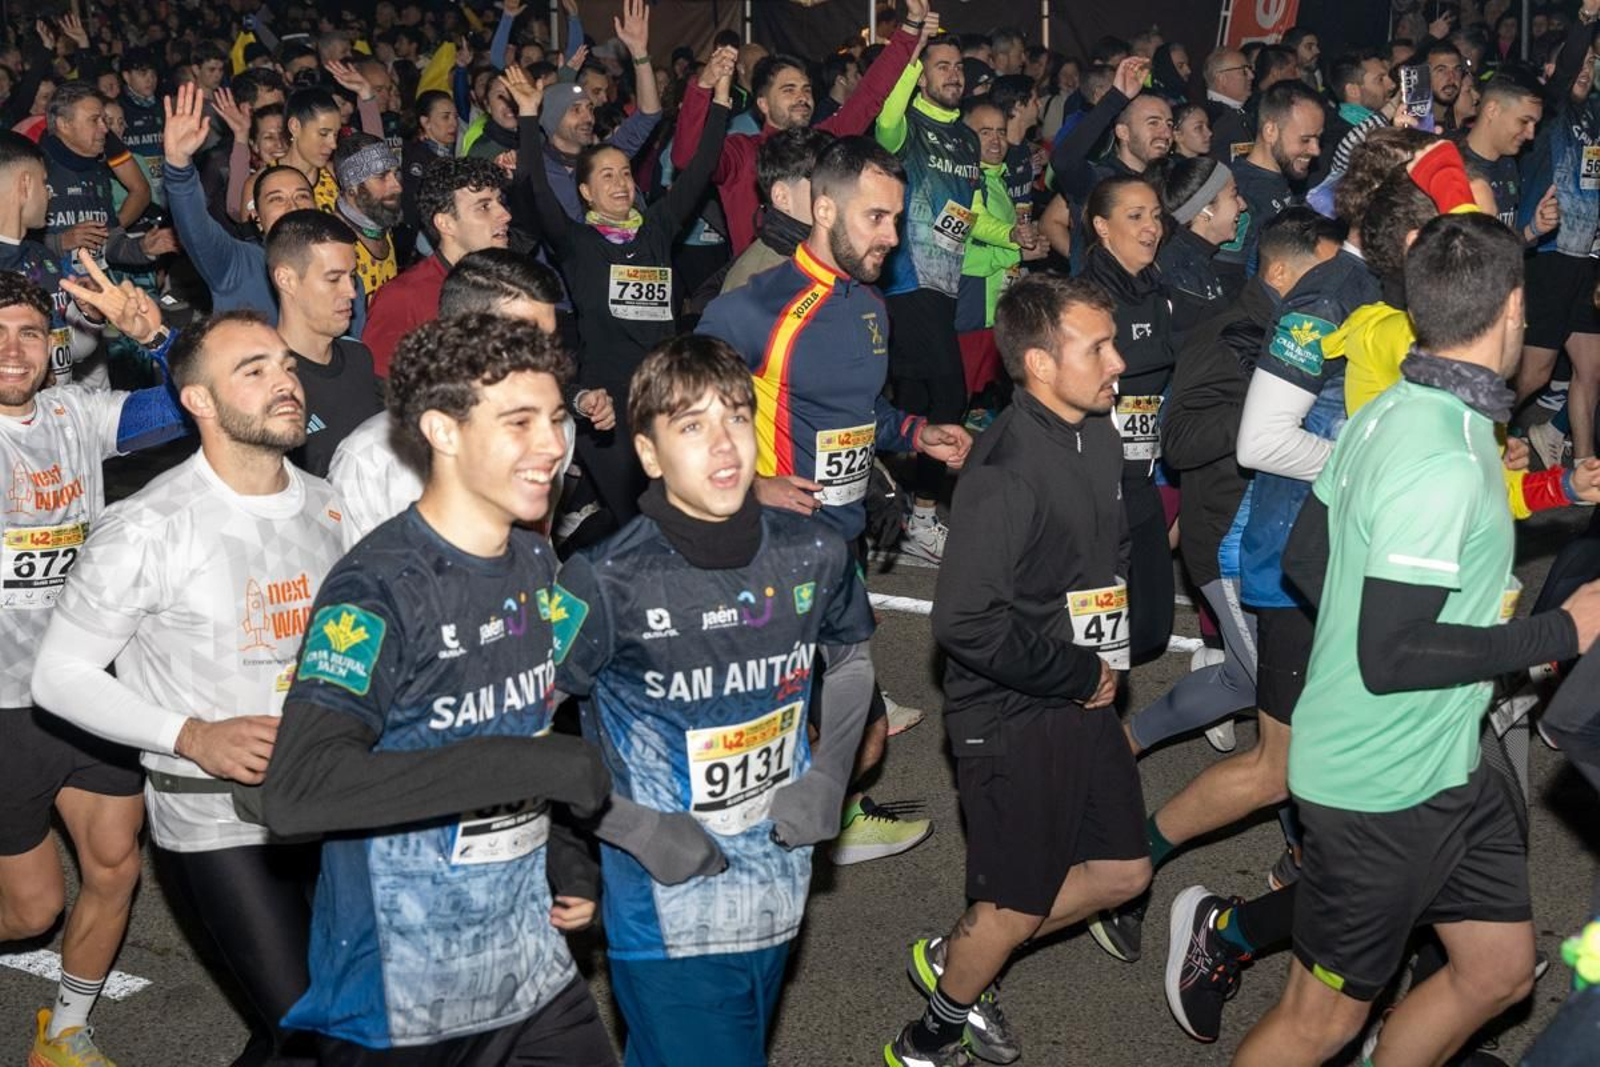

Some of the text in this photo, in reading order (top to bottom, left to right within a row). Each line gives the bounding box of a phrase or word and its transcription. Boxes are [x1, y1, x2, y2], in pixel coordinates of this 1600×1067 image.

[928, 155, 953, 174] SAN
[47, 211, 76, 227] SAN
[616, 281, 667, 301] 7385
[837, 432, 852, 446] 42
[30, 531, 51, 546] 42
[267, 573, 312, 606] next
[1095, 592, 1115, 609] 42
[701, 606, 739, 631] jaén
[643, 666, 714, 703] SAN
[722, 640, 816, 697] ANTÓN
[428, 684, 496, 731] SAN
[722, 730, 746, 751] 42
[704, 736, 787, 799] 9131
